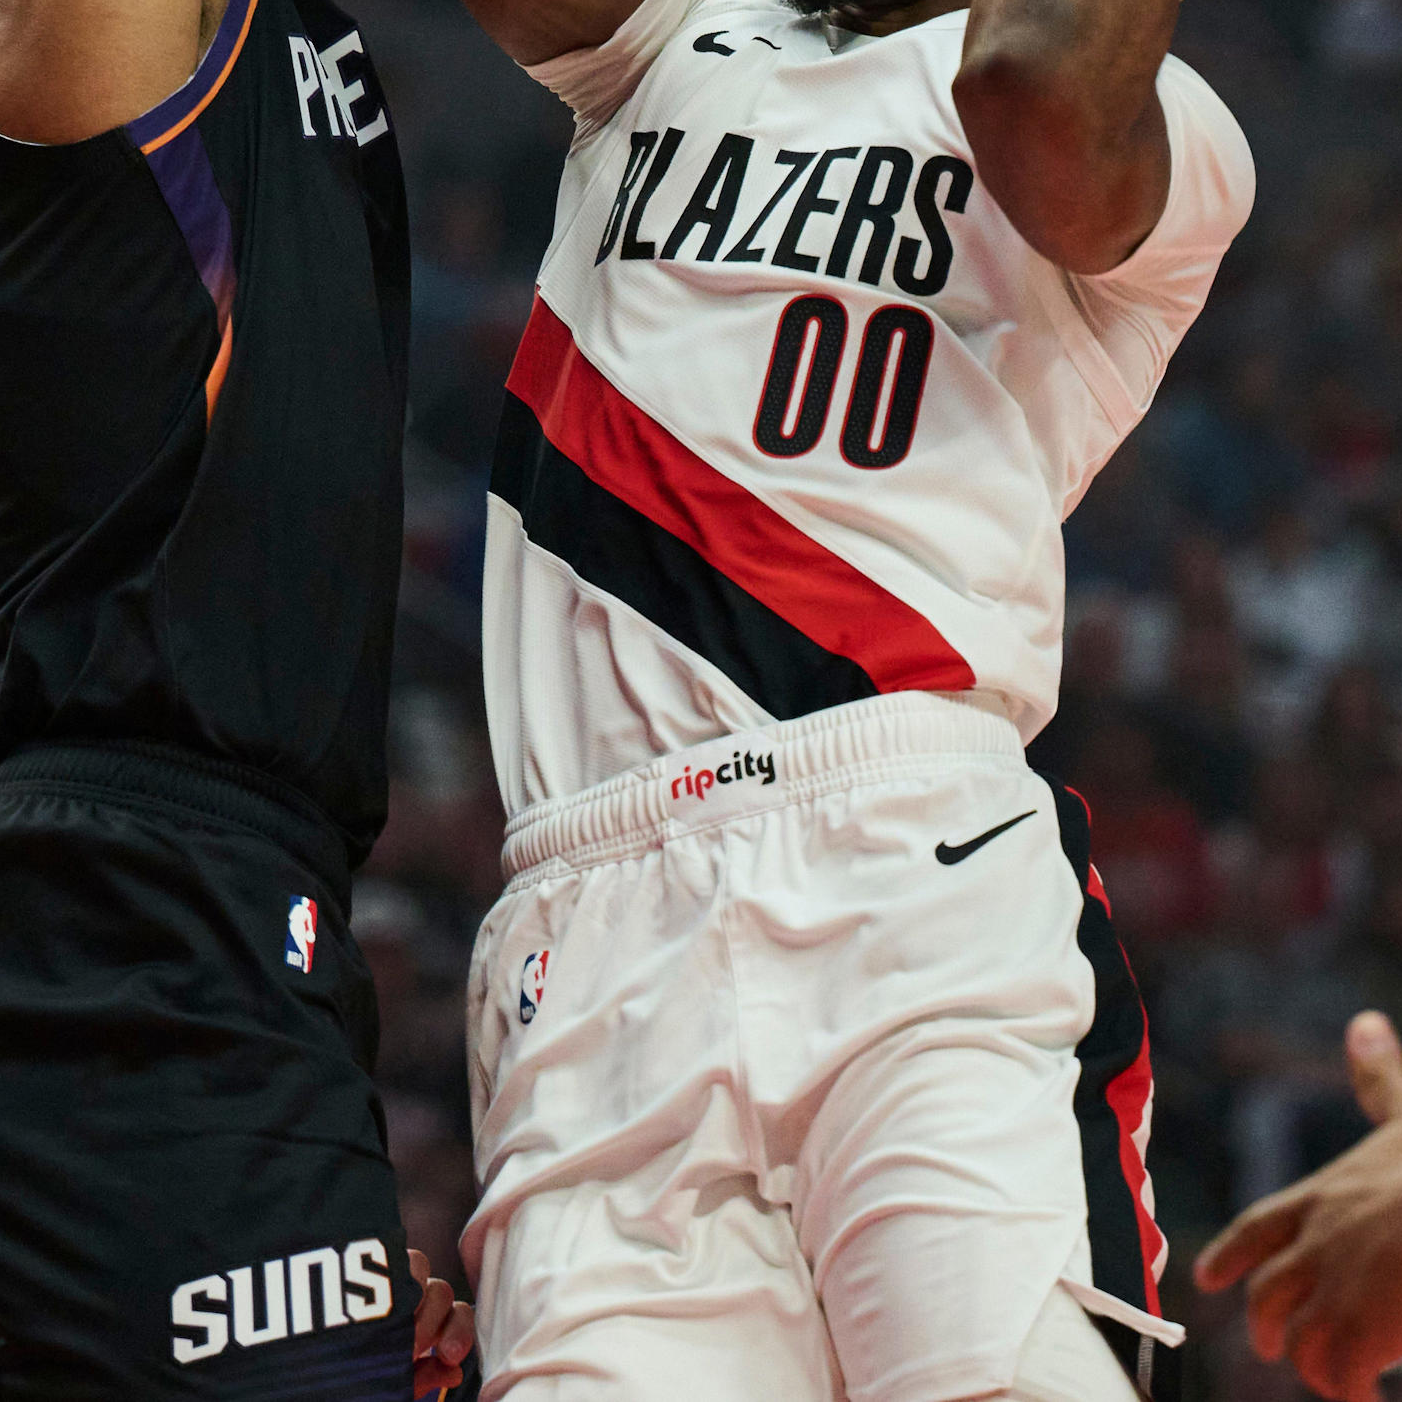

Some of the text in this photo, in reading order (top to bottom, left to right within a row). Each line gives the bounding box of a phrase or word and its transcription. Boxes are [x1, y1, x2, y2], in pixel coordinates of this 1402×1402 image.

[595, 127, 974, 296] BLAZERS
[752, 293, 935, 470] 00
[671, 750, 776, 801] ripcity
